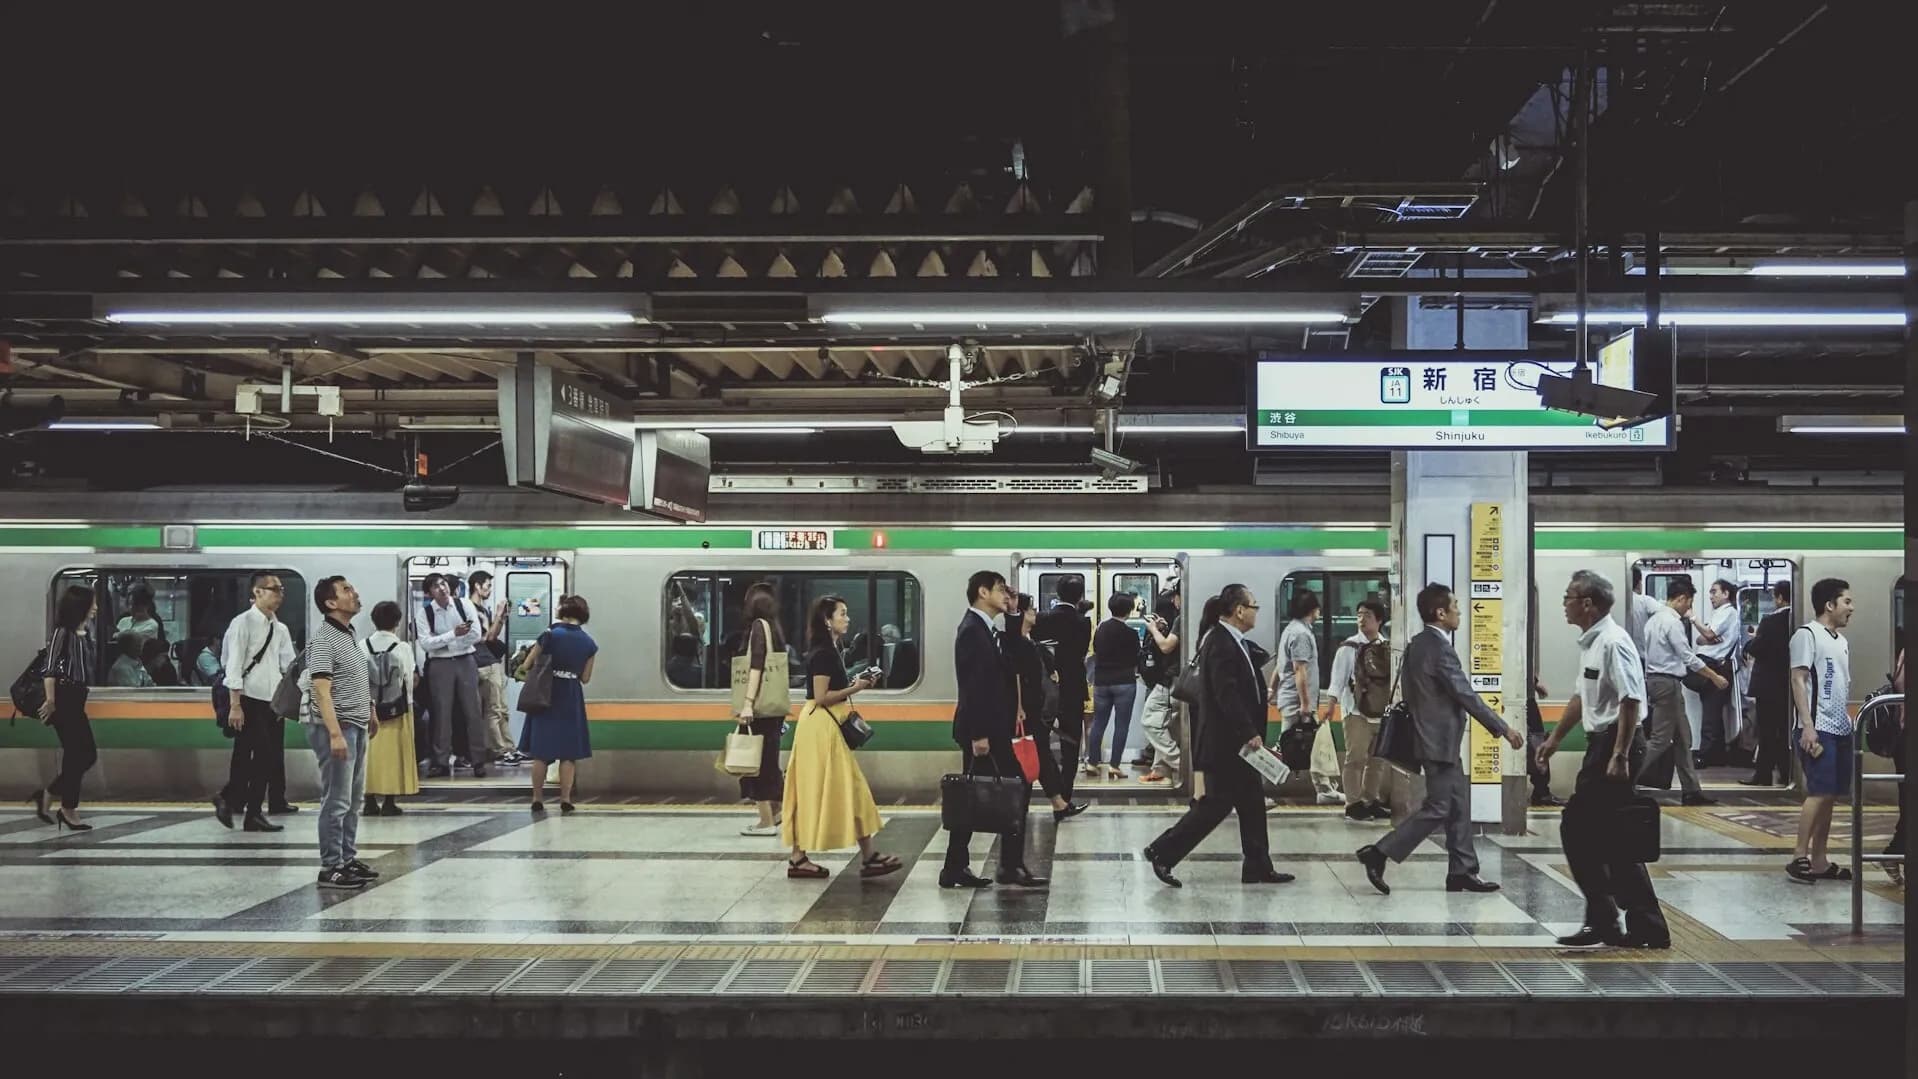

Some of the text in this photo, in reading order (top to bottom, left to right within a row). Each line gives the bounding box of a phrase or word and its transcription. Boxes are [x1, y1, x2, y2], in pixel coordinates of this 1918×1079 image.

[1387, 367, 1404, 376] SJK
[1390, 379, 1401, 387] JA
[1423, 367, 1497, 391] 新宿
[1389, 387, 1401, 397] 11
[1269, 411, 1297, 424] 渋谷
[1270, 430, 1305, 440] Shibuya
[1435, 430, 1485, 443] Shinjuku
[1585, 431, 1628, 440] Ikebukuro
[1824, 656, 1836, 679] Sport
